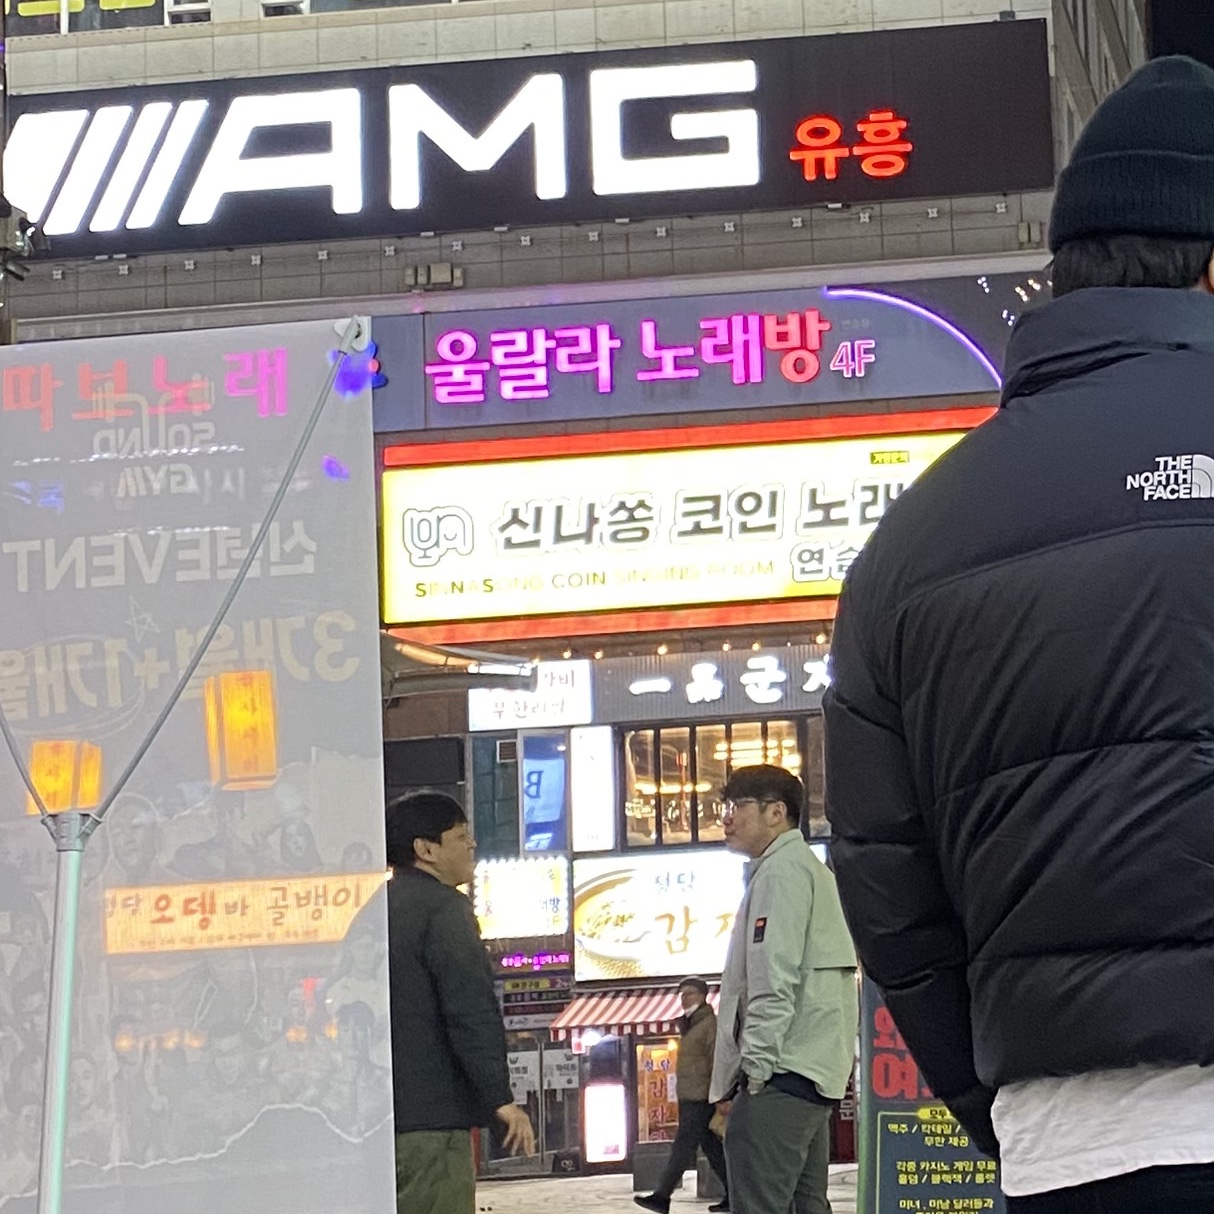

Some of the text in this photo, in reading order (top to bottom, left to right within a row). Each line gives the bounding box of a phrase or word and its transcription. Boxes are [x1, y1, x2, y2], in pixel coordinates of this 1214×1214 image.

[178, 58, 760, 226] AMG
[789, 108, 913, 182] 유흥
[425, 308, 876, 405] 울랄라 노래방 4F
[1155, 455, 1193, 470] THE
[1126, 469, 1191, 490] NORTH
[1143, 484, 1191, 501] FACE
[498, 499, 654, 550] 신나쏭
[677, 490, 778, 538] 코인
[552, 571, 606, 591] COIN
[266, 882, 362, 927] 골뱅이
[888, 1123, 909, 1134] 맥주
[948, 1136, 969, 1148] 제공
[896, 1161, 997, 1172] 각종 카지노 게임 무료
[931, 1173, 962, 1185] 블랙잭
[975, 1173, 996, 1184] 룰렛
[899, 1199, 921, 1211] 미녀
[929, 1199, 950, 1210] 미남
[953, 1198, 995, 1210] 딜러들과
